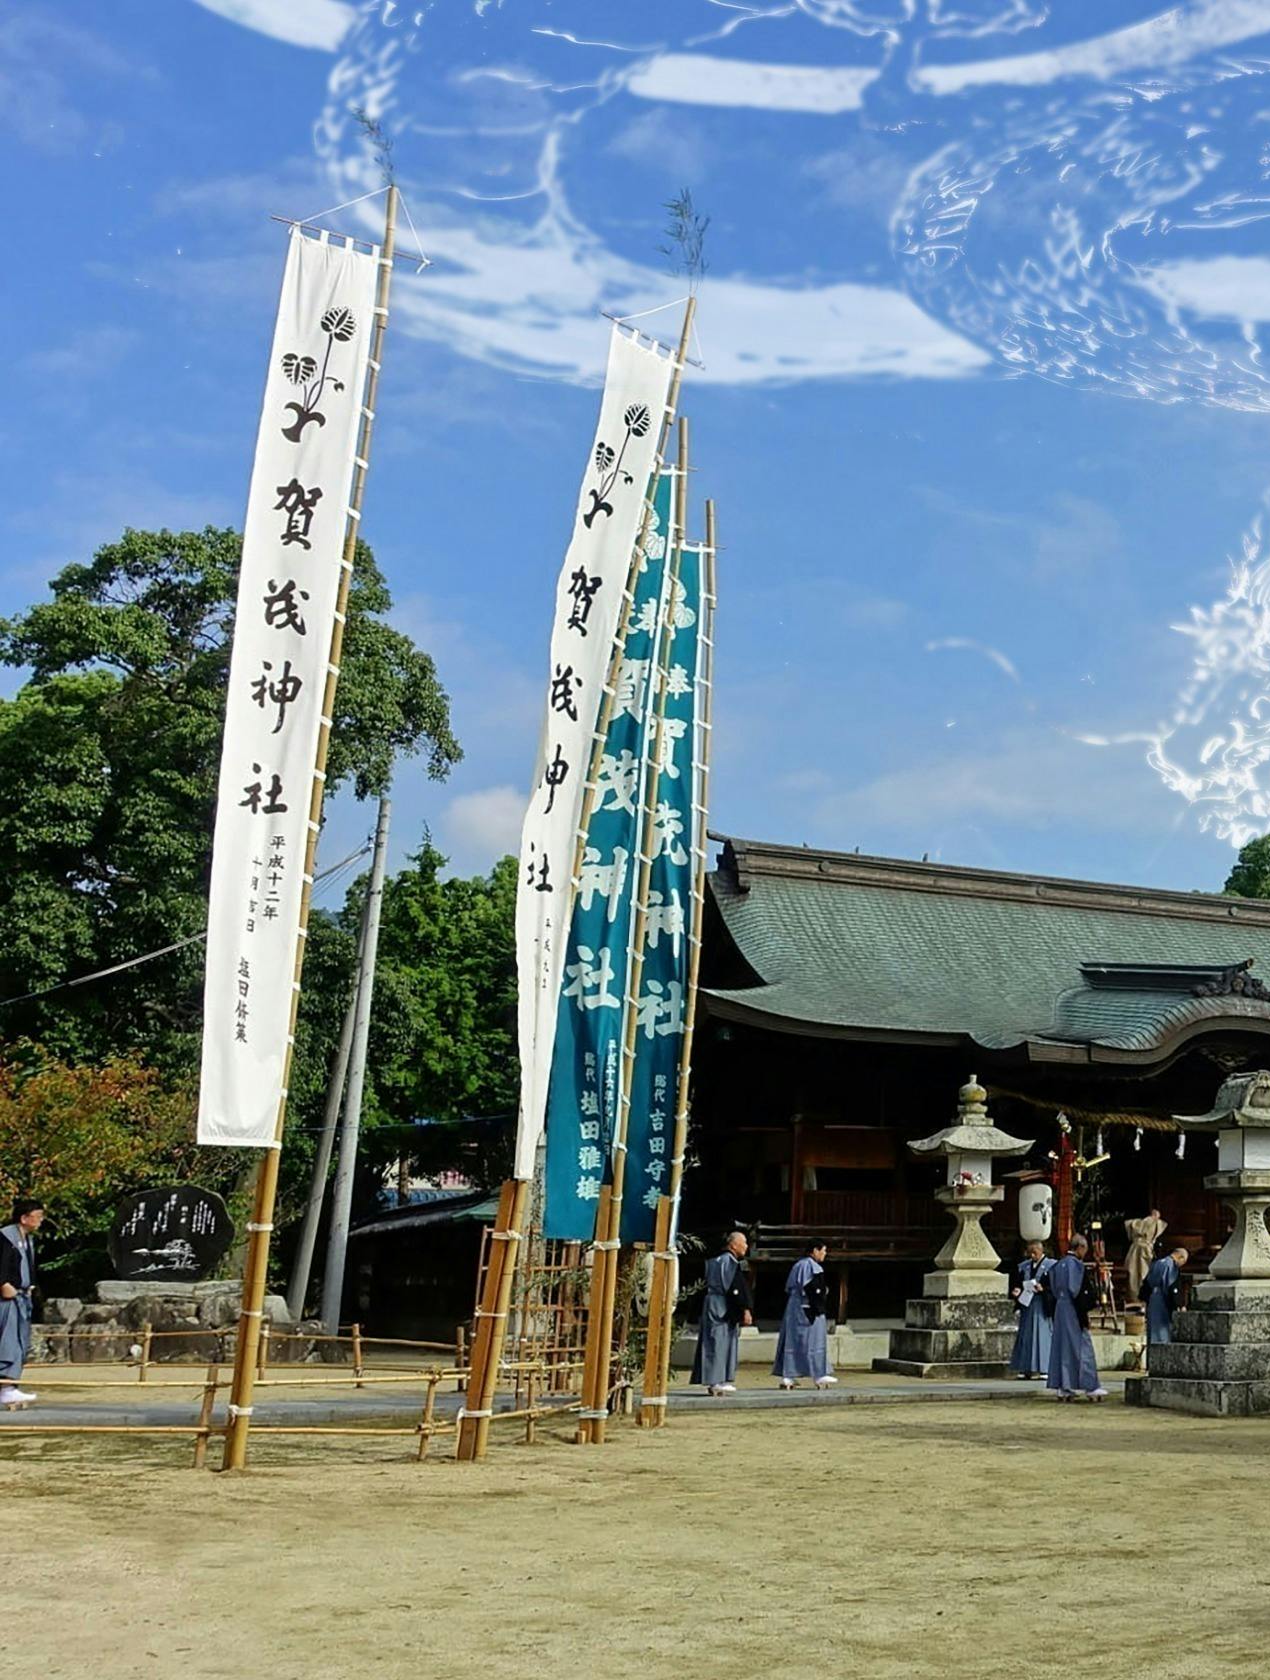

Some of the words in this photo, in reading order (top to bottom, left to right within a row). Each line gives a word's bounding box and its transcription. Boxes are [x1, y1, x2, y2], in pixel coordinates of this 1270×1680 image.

[238, 478, 323, 815] 賀茂神社
[262, 835, 286, 920] 平成十二年
